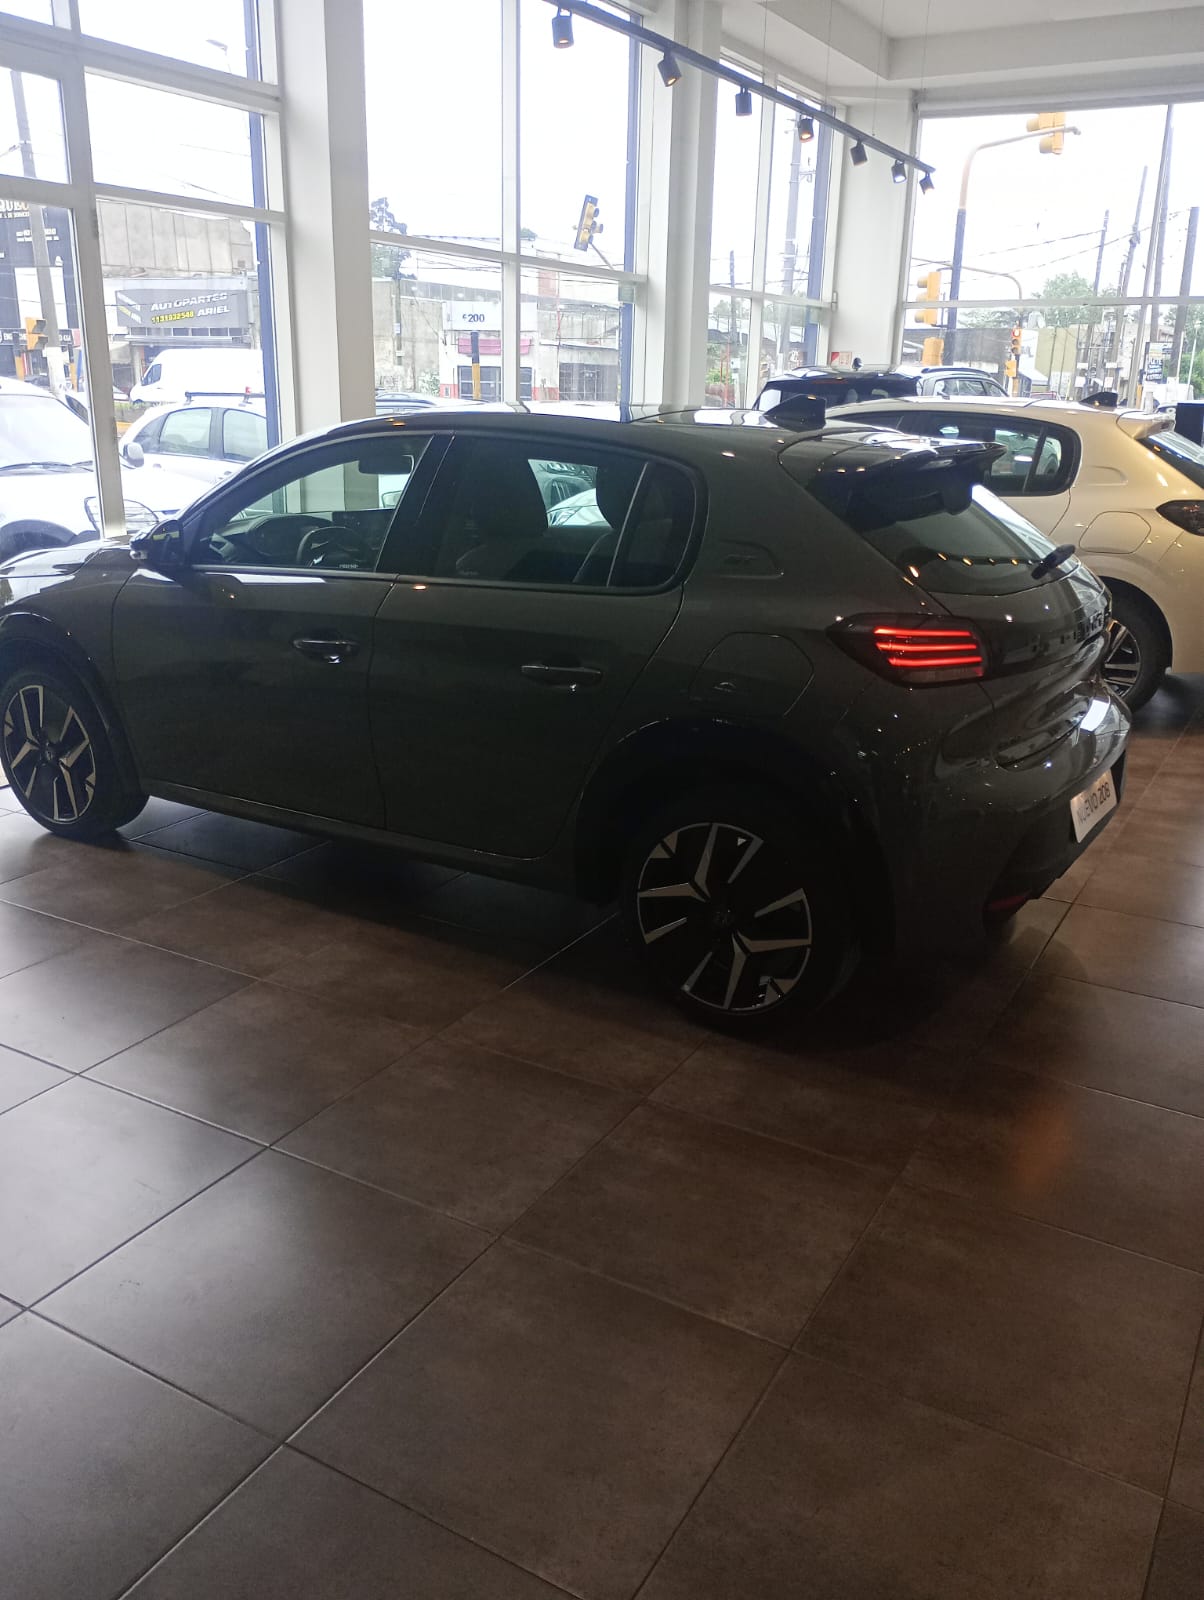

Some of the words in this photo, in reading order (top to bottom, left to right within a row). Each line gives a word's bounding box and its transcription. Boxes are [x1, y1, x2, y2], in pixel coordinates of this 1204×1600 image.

[150, 292, 228, 312] AUTOPARTES
[197, 305, 230, 317] ARIEL
[1076, 791, 1099, 824] NUEVO
[1097, 781, 1113, 806] 208
